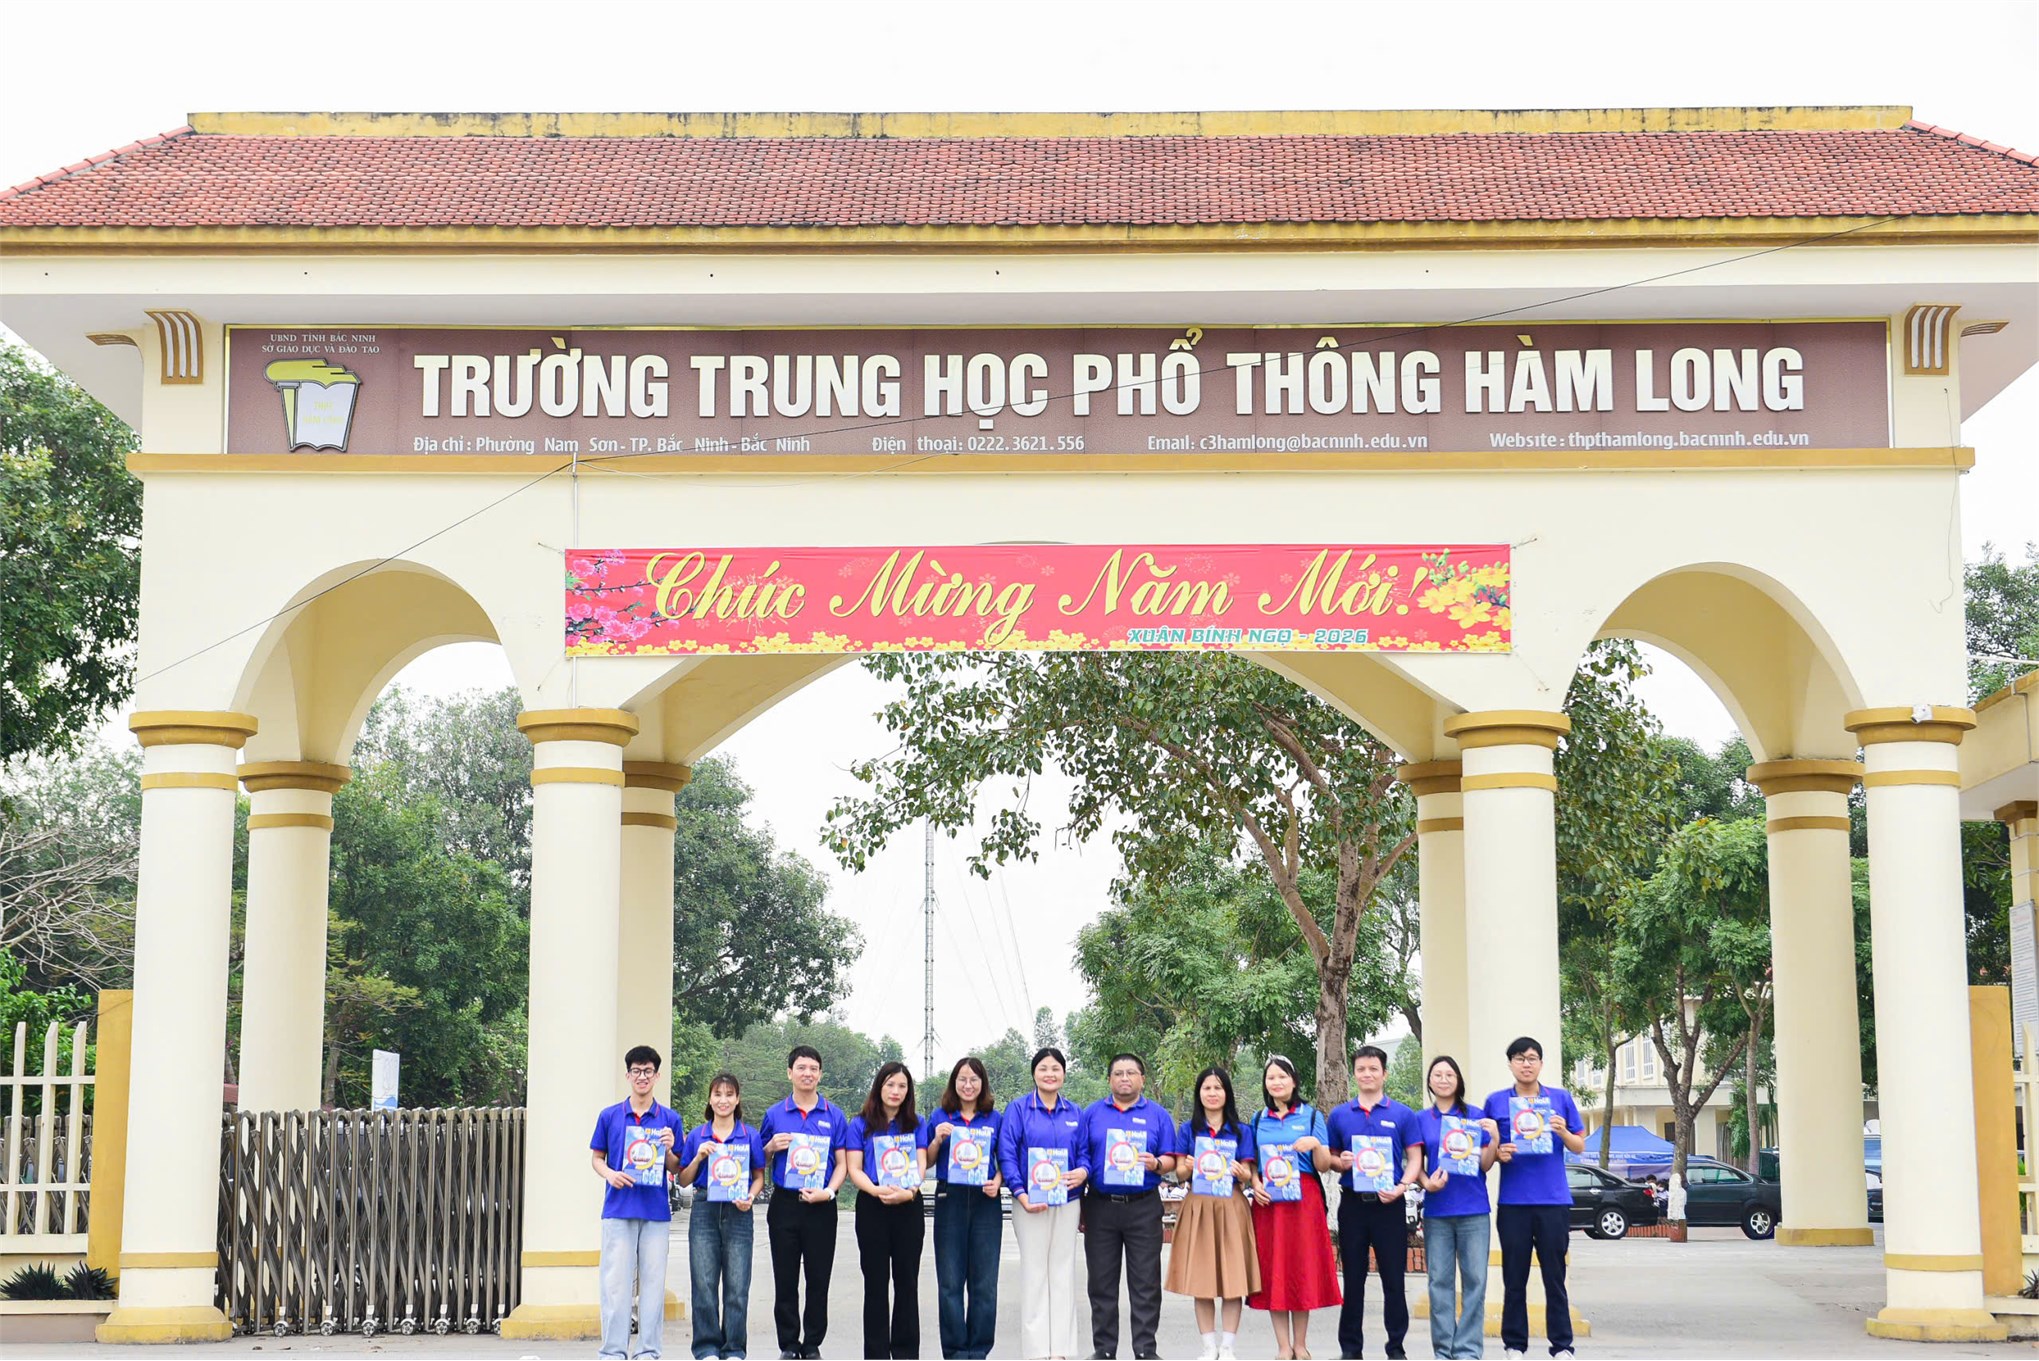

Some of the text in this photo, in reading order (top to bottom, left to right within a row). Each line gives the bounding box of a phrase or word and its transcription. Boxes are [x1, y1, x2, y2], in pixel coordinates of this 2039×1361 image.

[270, 334, 297, 342] UBND
[330, 331, 348, 342] BẮC
[352, 334, 376, 343] NINH
[261, 343, 380, 355] SỞ GIÁO DỤC VÀ ĐÀO TẠO
[413, 327, 1804, 430] TRƯỜNG TRUNG HỌC PHỔ THÔNG HÀM LONG
[413, 436, 438, 455] Địa
[476, 435, 535, 455] Phường
[545, 437, 579, 452] Nam
[589, 437, 618, 452] Sơn
[657, 433, 683, 452] Bắc
[695, 437, 729, 452] Ninh
[742, 432, 768, 452] Bắc
[776, 437, 810, 452] Ninh
[872, 435, 1085, 454] Điện thoại: 0222.3621.556
[1148, 433, 1428, 452] Email: c3hamlong@bacninh.edu.vn
[1568, 430, 1810, 450] thpthamlong.bacninh.edu.vn
[646, 548, 1429, 648] Chúc Mừng Năm Mới!
[1128, 627, 1185, 643] XUÂN
[1191, 625, 1241, 643] BÍNH
[1249, 629, 1293, 646] NGỌ
[1314, 629, 1368, 643] 2026
